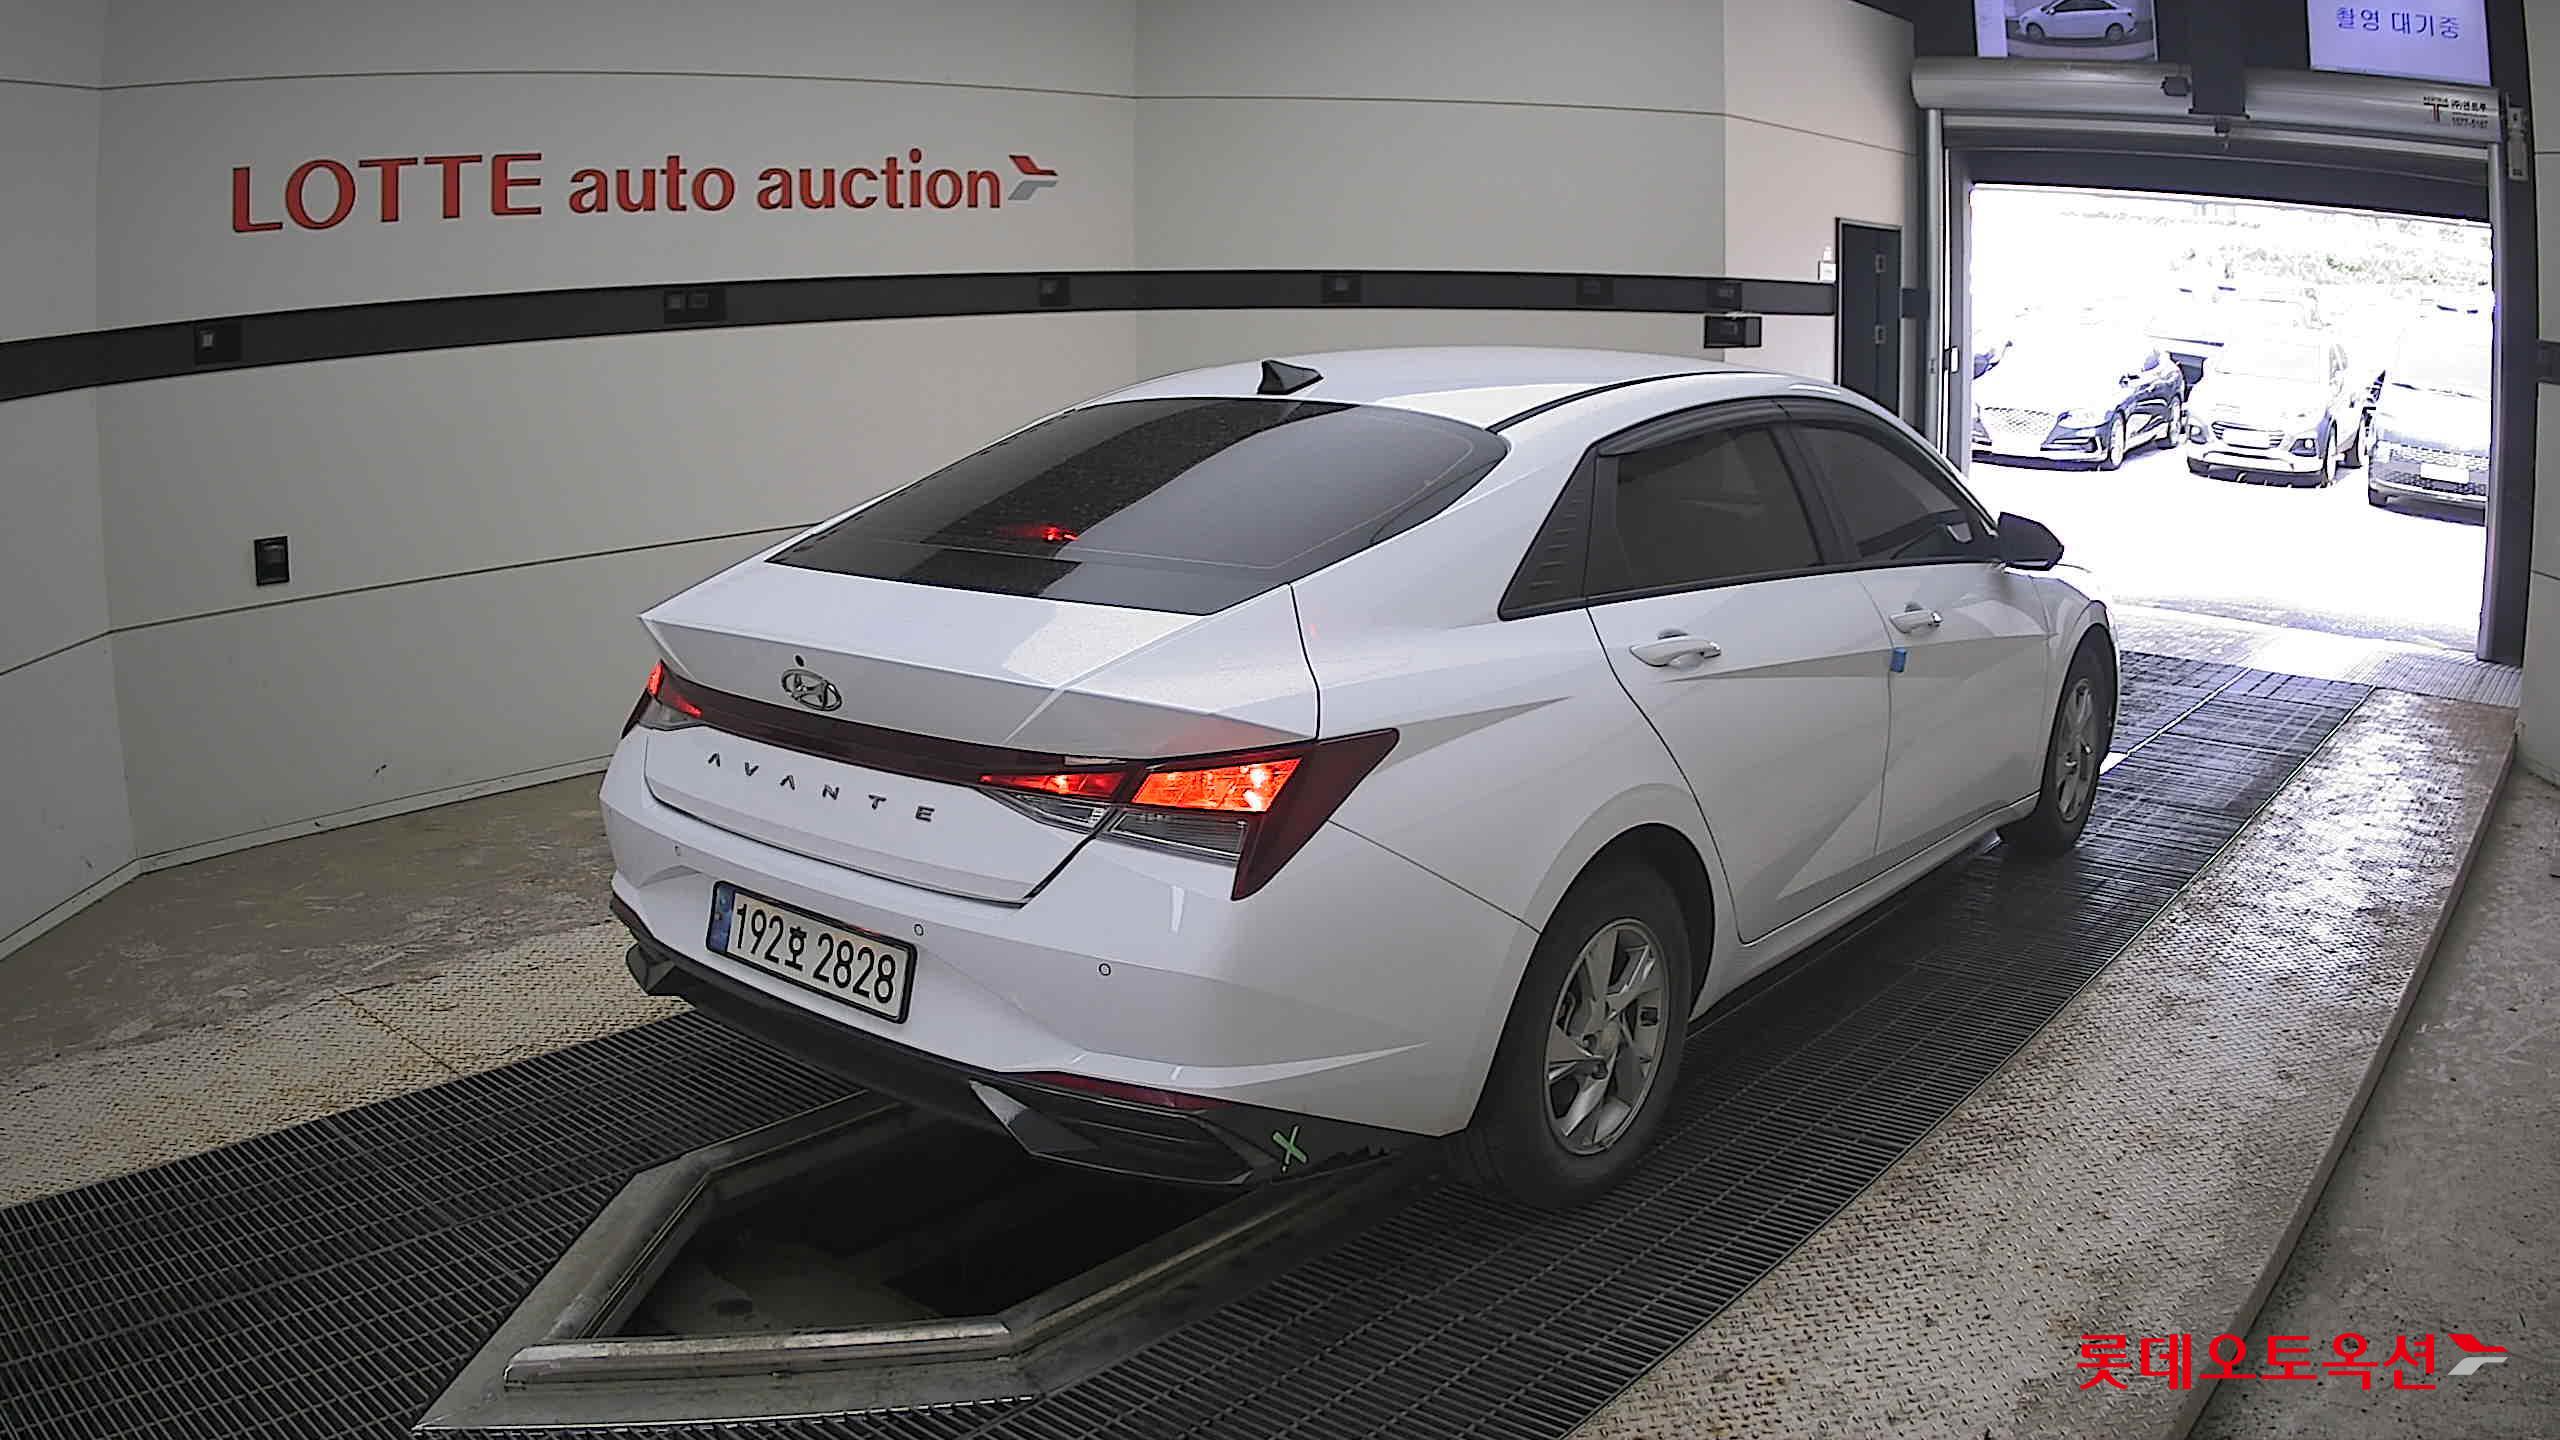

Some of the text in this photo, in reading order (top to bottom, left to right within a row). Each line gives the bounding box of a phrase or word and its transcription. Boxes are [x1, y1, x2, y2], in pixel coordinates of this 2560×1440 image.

[2336, 7, 2460, 39] 촬영 대기중
[232, 148, 1001, 233] LOTTE auto auction
[707, 752, 935, 822] AVANTE
[736, 903, 897, 1004] 192호 2828
